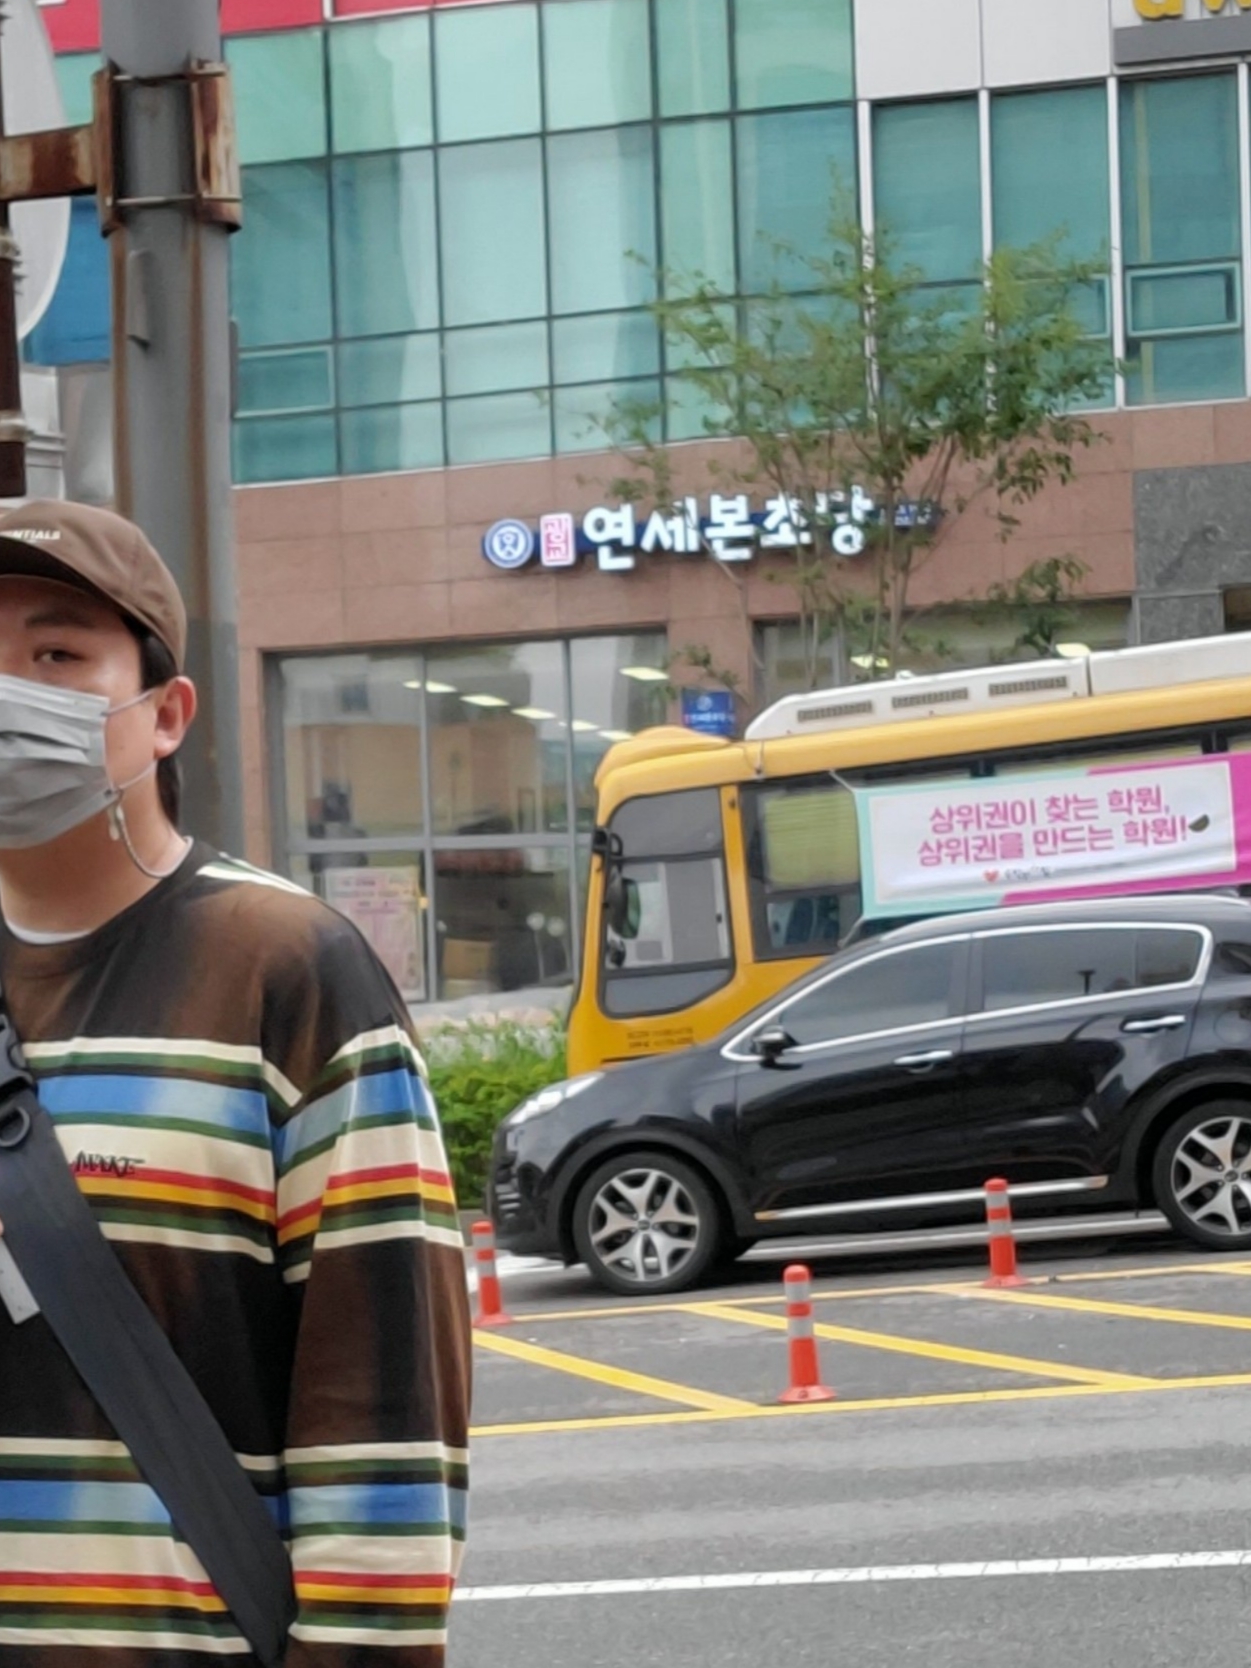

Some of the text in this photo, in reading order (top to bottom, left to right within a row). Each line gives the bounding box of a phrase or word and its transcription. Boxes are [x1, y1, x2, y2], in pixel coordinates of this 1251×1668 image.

[583, 485, 873, 571] 연세본초당
[929, 785, 1171, 836] 상위권이 찾는 학원,
[918, 815, 1188, 868] 상위권을 만드는 학원!
